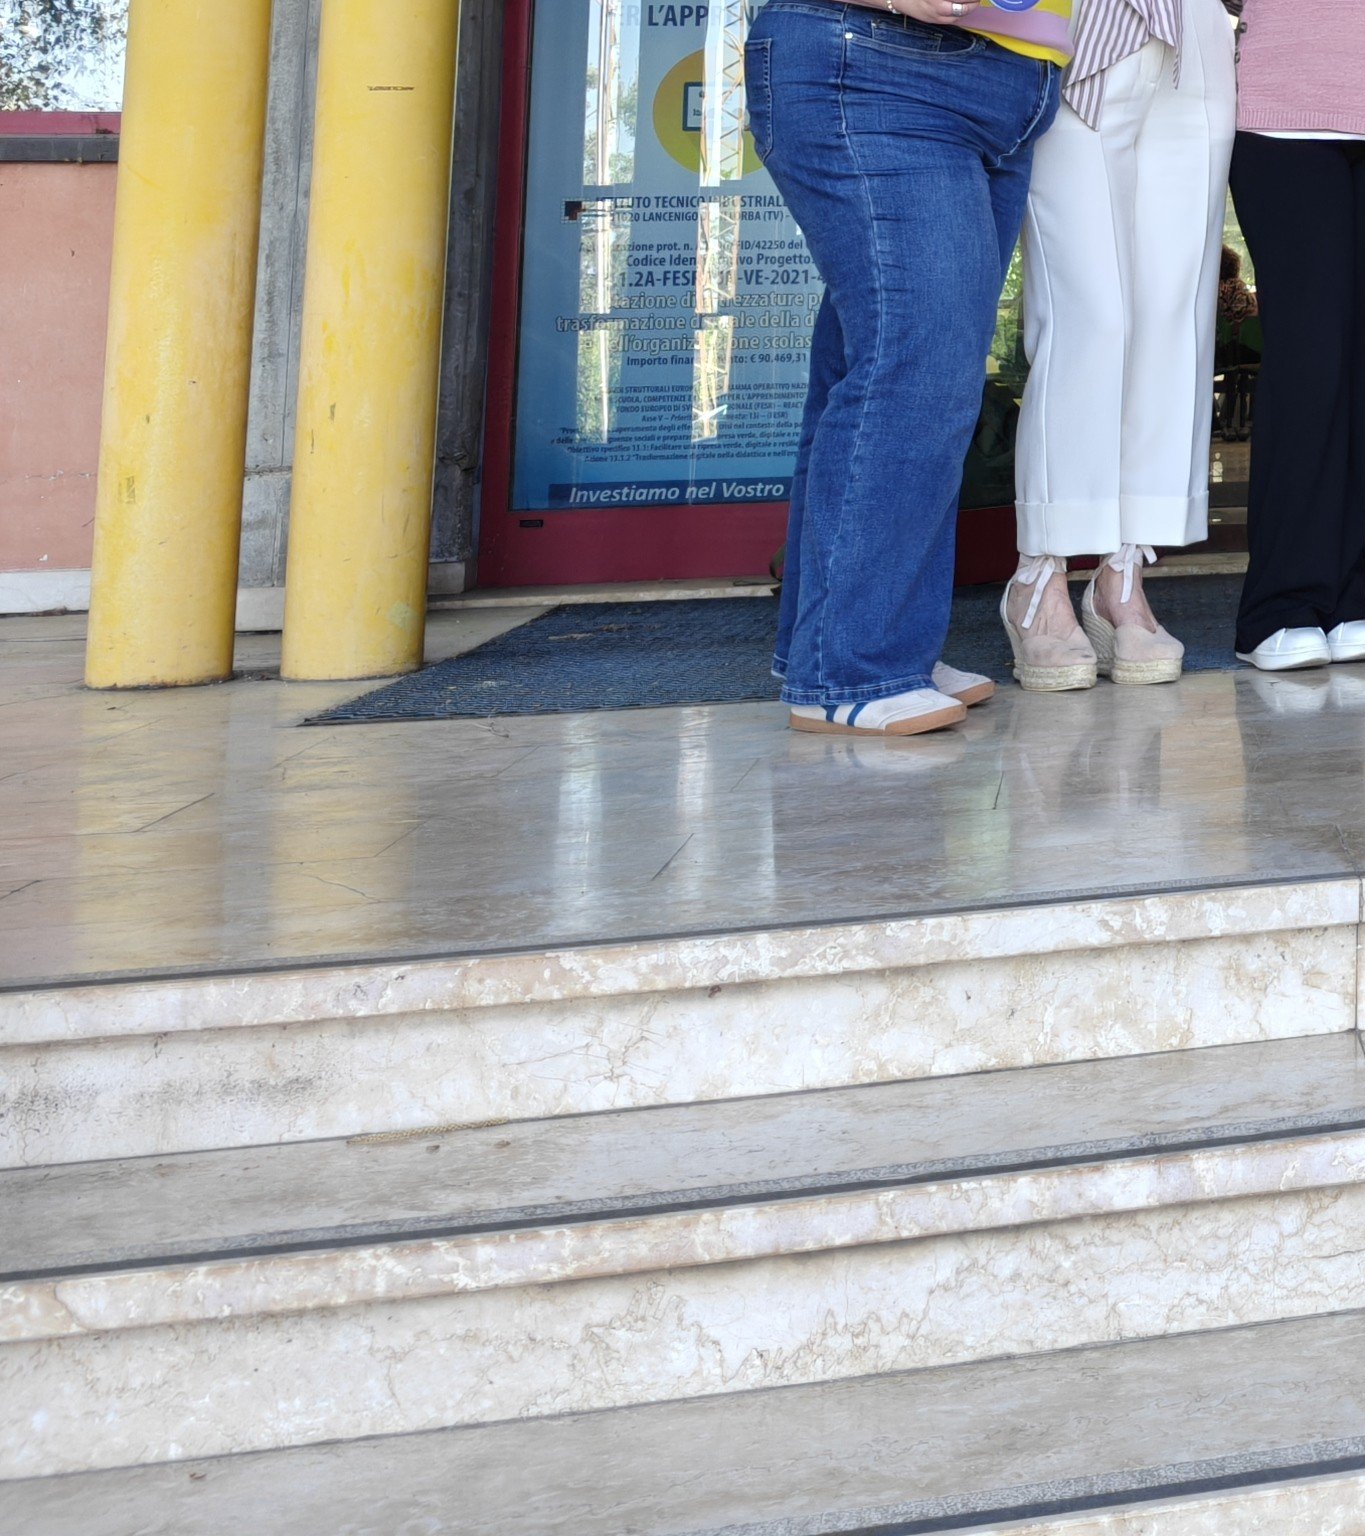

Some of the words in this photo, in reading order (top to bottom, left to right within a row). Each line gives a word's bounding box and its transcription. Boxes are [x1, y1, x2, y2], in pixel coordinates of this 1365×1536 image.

[655, 195, 706, 209] TECNICO
[708, 194, 788, 208] IDUSTRIAL
[643, 210, 698, 222] LANCENIGO
[763, 208, 784, 223] (TV)
[657, 241, 680, 254] prot.
[787, 238, 803, 251] del
[627, 254, 666, 267] Codice
[759, 311, 800, 329] della
[762, 333, 812, 350] scolas
[627, 355, 668, 367] Importo
[569, 484, 680, 504] Investiamo
[688, 481, 716, 500] nel
[722, 481, 785, 498] Vostro
